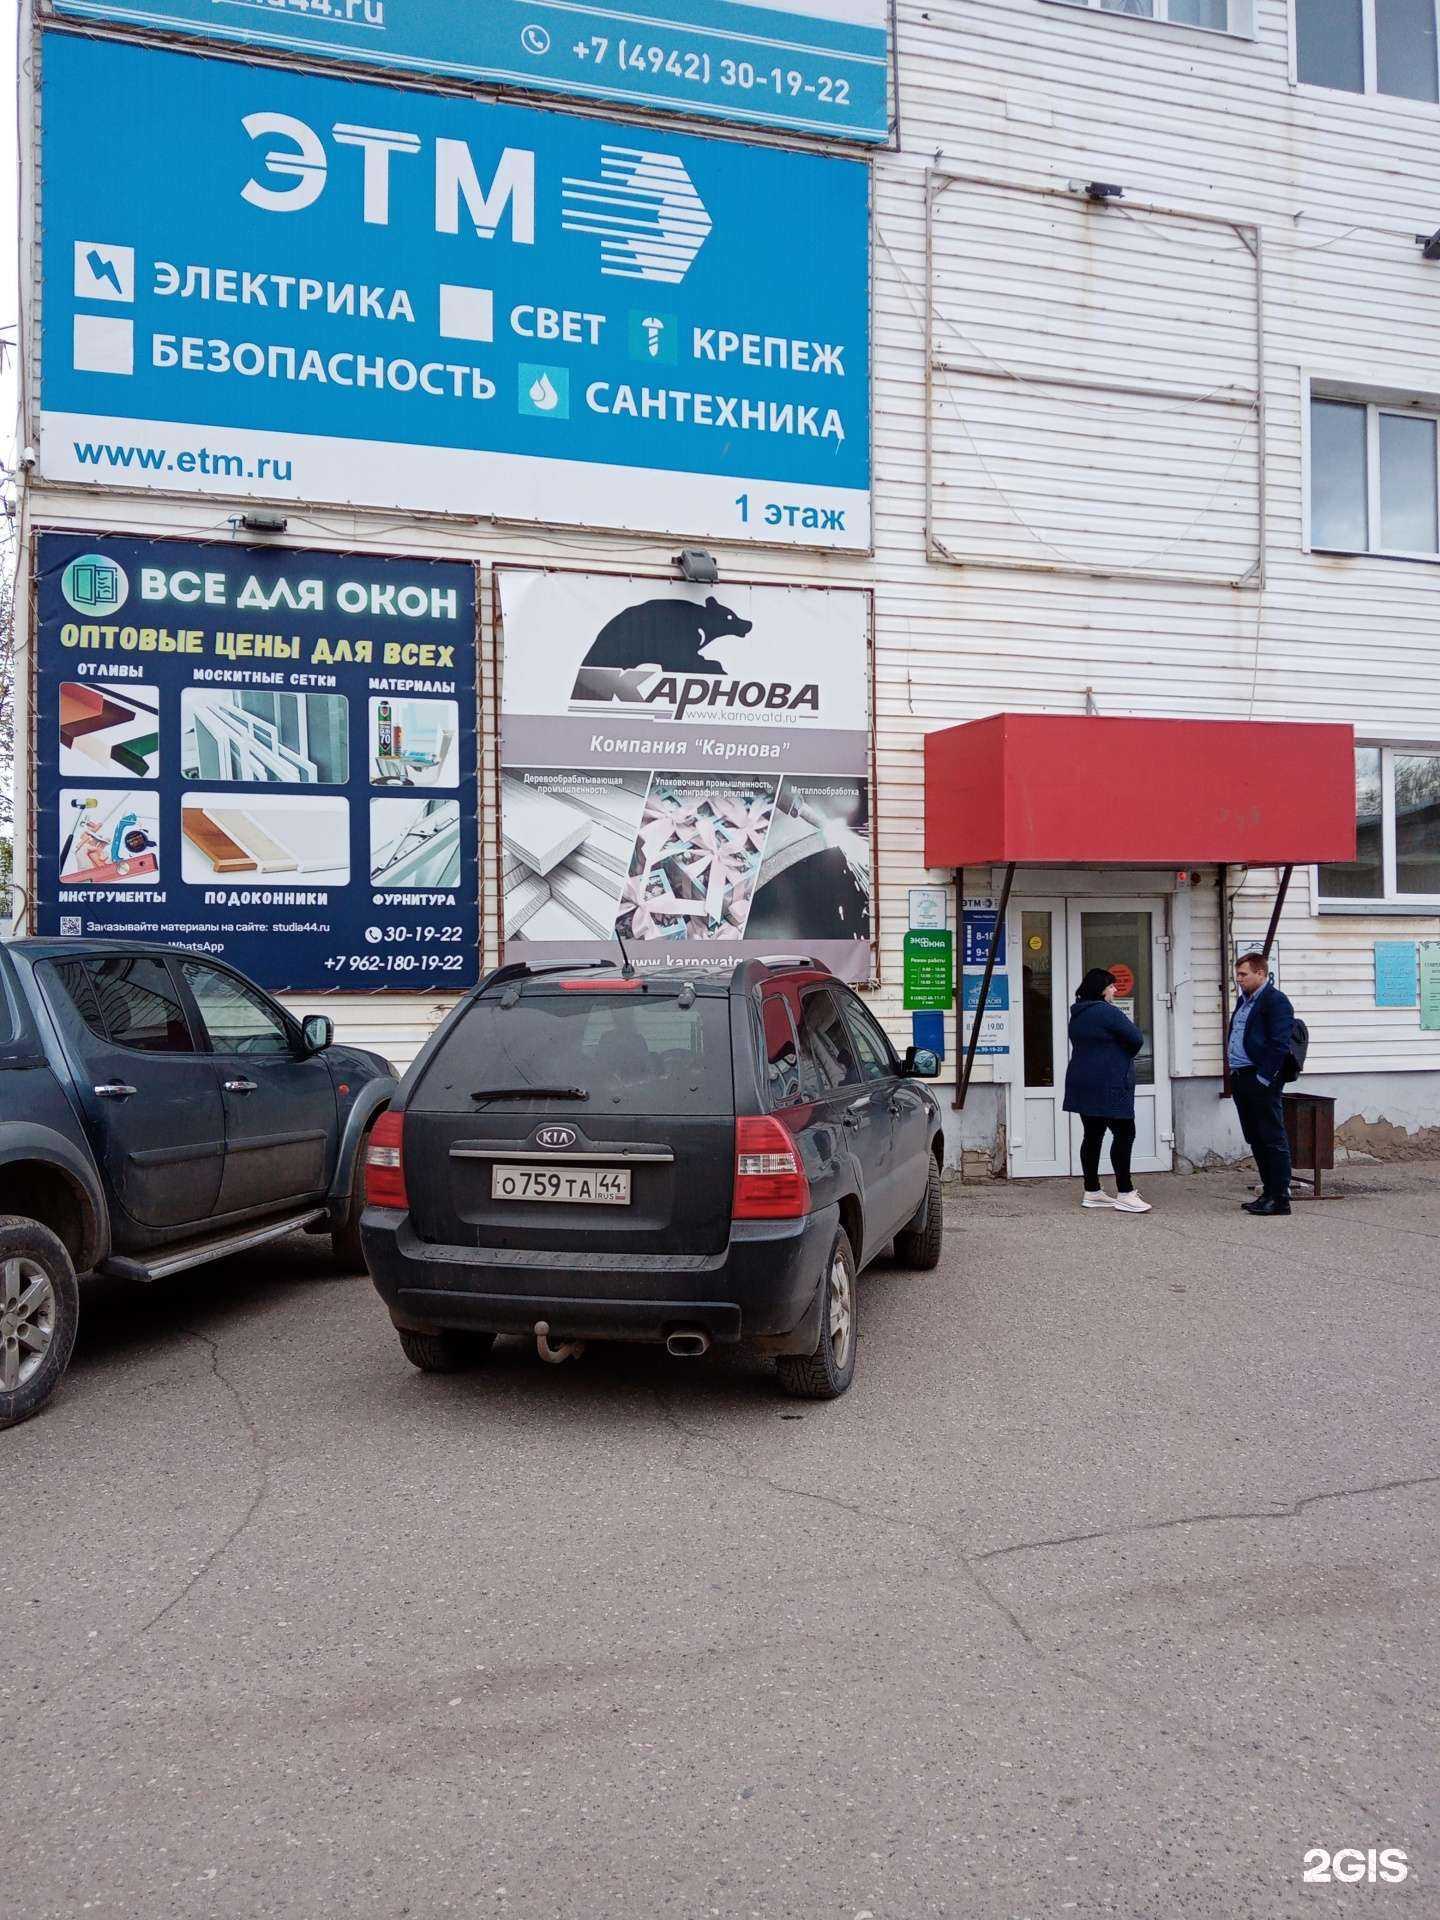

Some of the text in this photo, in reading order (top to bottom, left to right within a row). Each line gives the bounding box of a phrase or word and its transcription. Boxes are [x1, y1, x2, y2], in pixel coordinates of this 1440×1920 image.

[573, 36, 850, 104] +7 (4942) 30-19-22
[240, 111, 535, 245] ЭТМ
[153, 261, 415, 322] ЭЛЕКТРИКА
[510, 304, 606, 345] СВЕТ
[693, 327, 845, 376] КРЕПЕЖ
[152, 334, 496, 400] БЕЗОПАСНОСТЬ
[586, 381, 845, 439] САНТЕХНИКА
[74, 441, 292, 480] www.etm.ru
[735, 494, 845, 531] 1 этаж
[141, 568, 457, 619] ВСЕ ДЛЯ ОКОН
[60, 624, 455, 667] ОПТОВЫЕ ЦЕНЫ ДЛЯ ВСЕХ
[77, 663, 143, 677] ОТЛИВЫ
[193, 668, 336, 687] МОСКИТНЫЕ СЕТКИ
[369, 678, 455, 693] МАТЕРИАЛЫ
[571, 668, 819, 720] КАРНОВА
[686, 709, 797, 724] www.karnovatd.ru
[590, 735, 687, 755] Компания
[524, 773, 623, 785] Деревообрабатывающая
[655, 777, 704, 787] Упаковочная
[537, 785, 608, 795] промышленность
[791, 786, 859, 796] Металлообработка
[58, 891, 166, 903] ИНСТРУМЕНТЫ
[204, 891, 328, 907] ПОДОКОННИКИ
[372, 894, 456, 906] ФУРНИТУРА
[87, 922, 330, 933] Заказывайте материалы на сайте: studia44.ru
[384, 926, 463, 942] 30-19-22
[324, 955, 464, 971] +7 962-180-19-22
[542, 1131, 569, 1144] KIA
